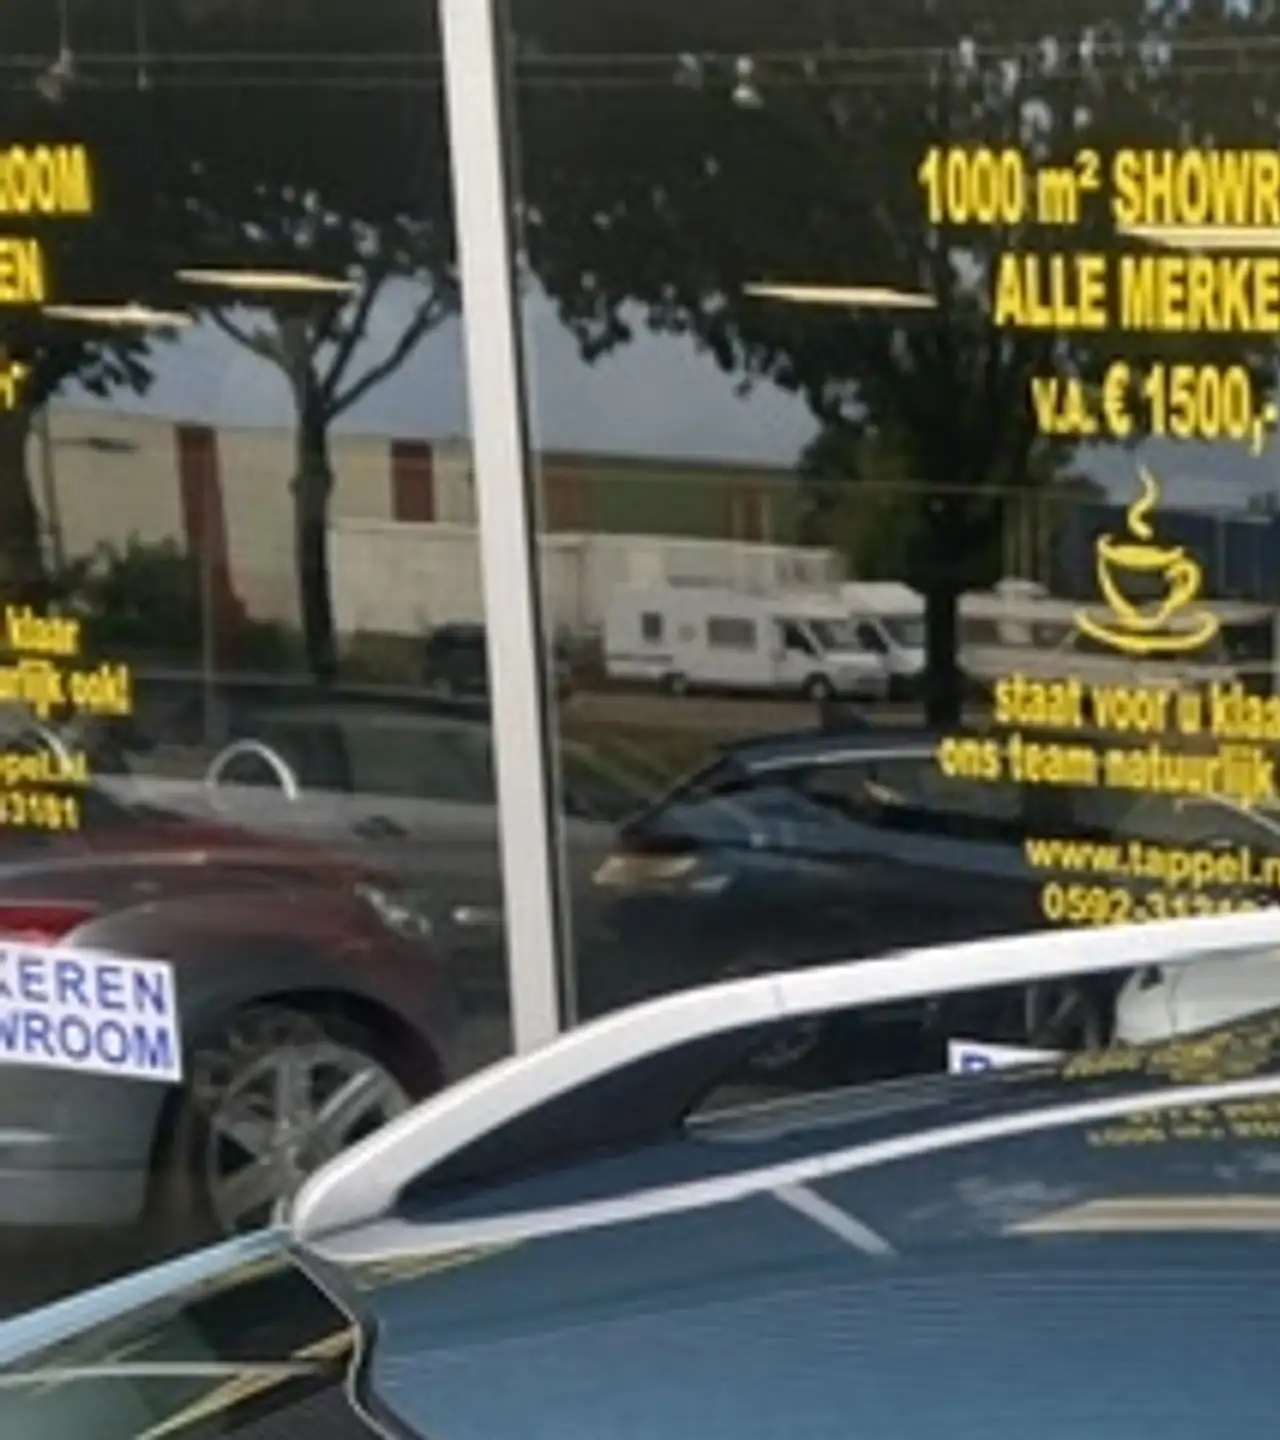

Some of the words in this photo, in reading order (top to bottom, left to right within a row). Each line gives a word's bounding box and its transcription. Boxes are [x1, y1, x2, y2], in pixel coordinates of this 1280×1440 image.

[917, 148, 1024, 224] 1000
[994, 256, 1106, 328] ALLE
[1103, 362, 1132, 438] €
[994, 674, 1083, 728] staat
[1093, 684, 1166, 732] voor
[1177, 693, 1202, 735] u
[938, 736, 998, 778] ons
[1007, 732, 1096, 784] team
[1105, 743, 1274, 808] natuurlijk
